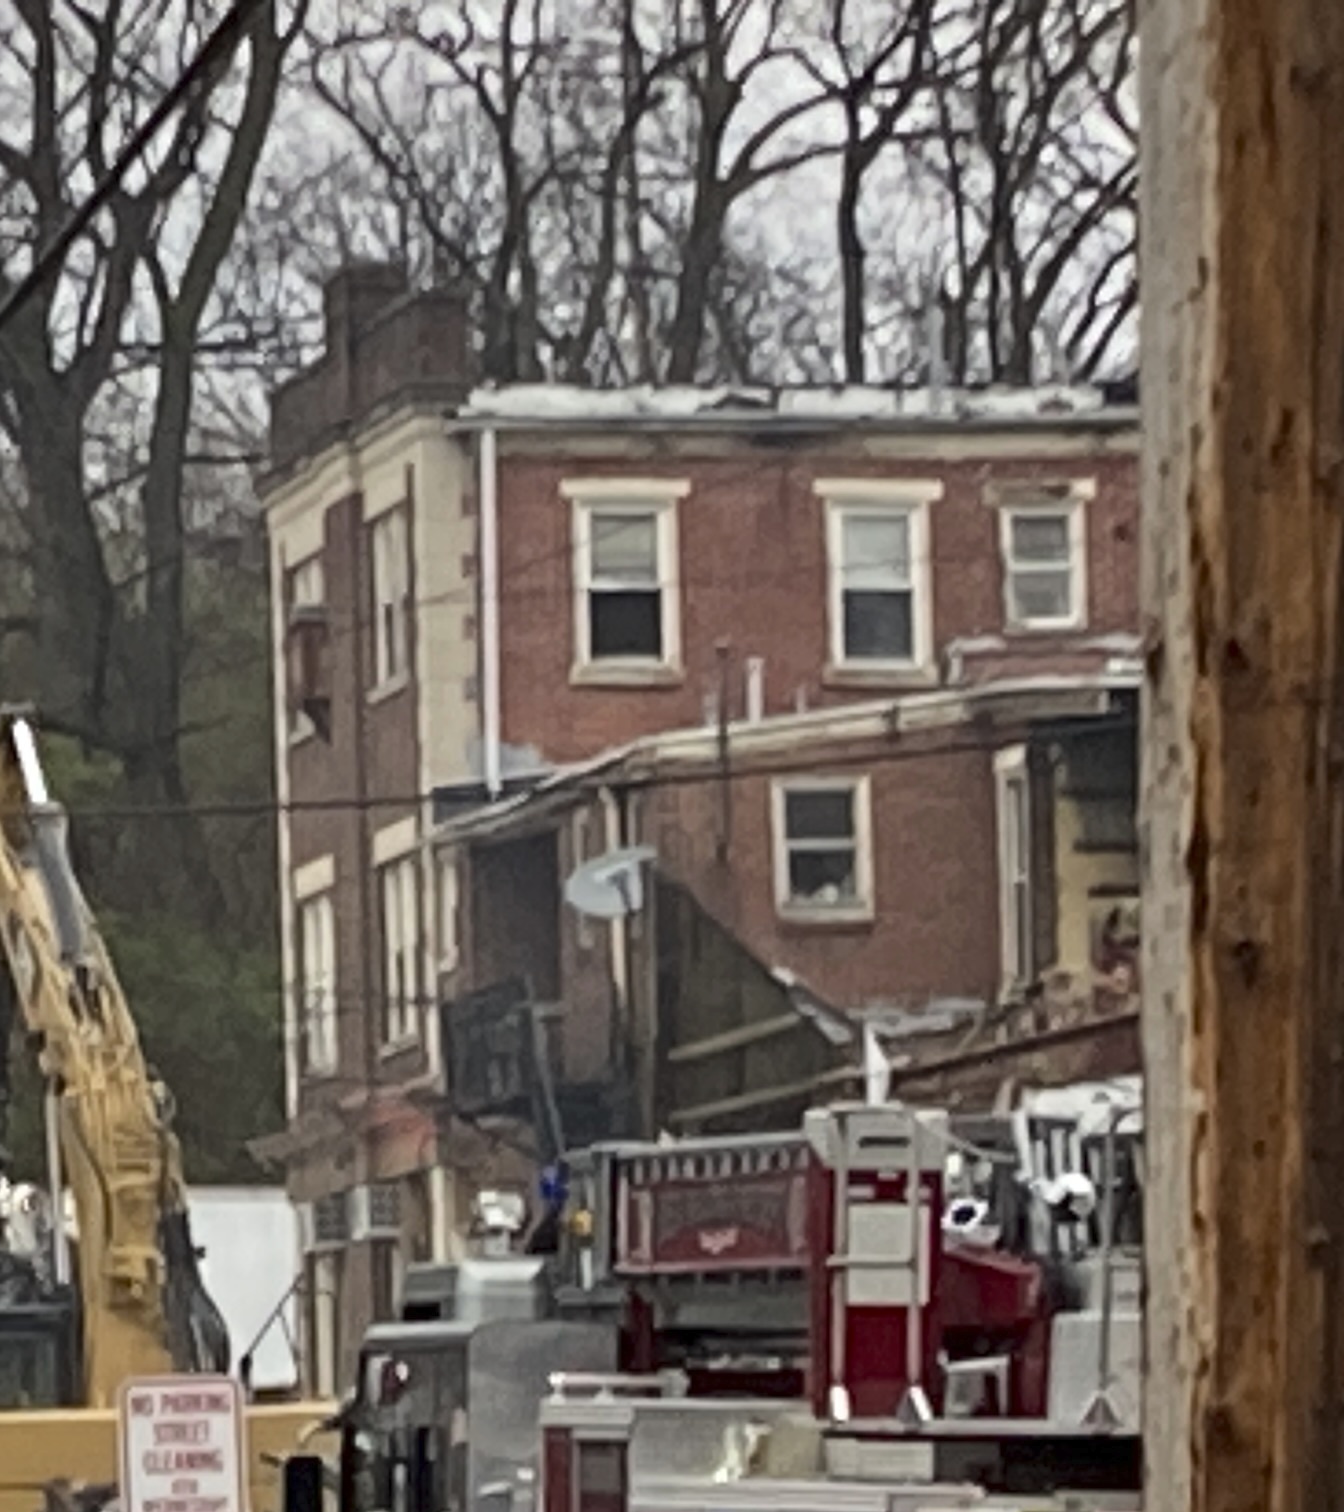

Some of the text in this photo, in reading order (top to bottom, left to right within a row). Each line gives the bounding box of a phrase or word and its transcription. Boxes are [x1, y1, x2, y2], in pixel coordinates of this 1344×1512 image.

[131, 1393, 232, 1417] NO PARKING
[153, 1420, 210, 1446] STREET
[142, 1450, 224, 1476] CLEANING
